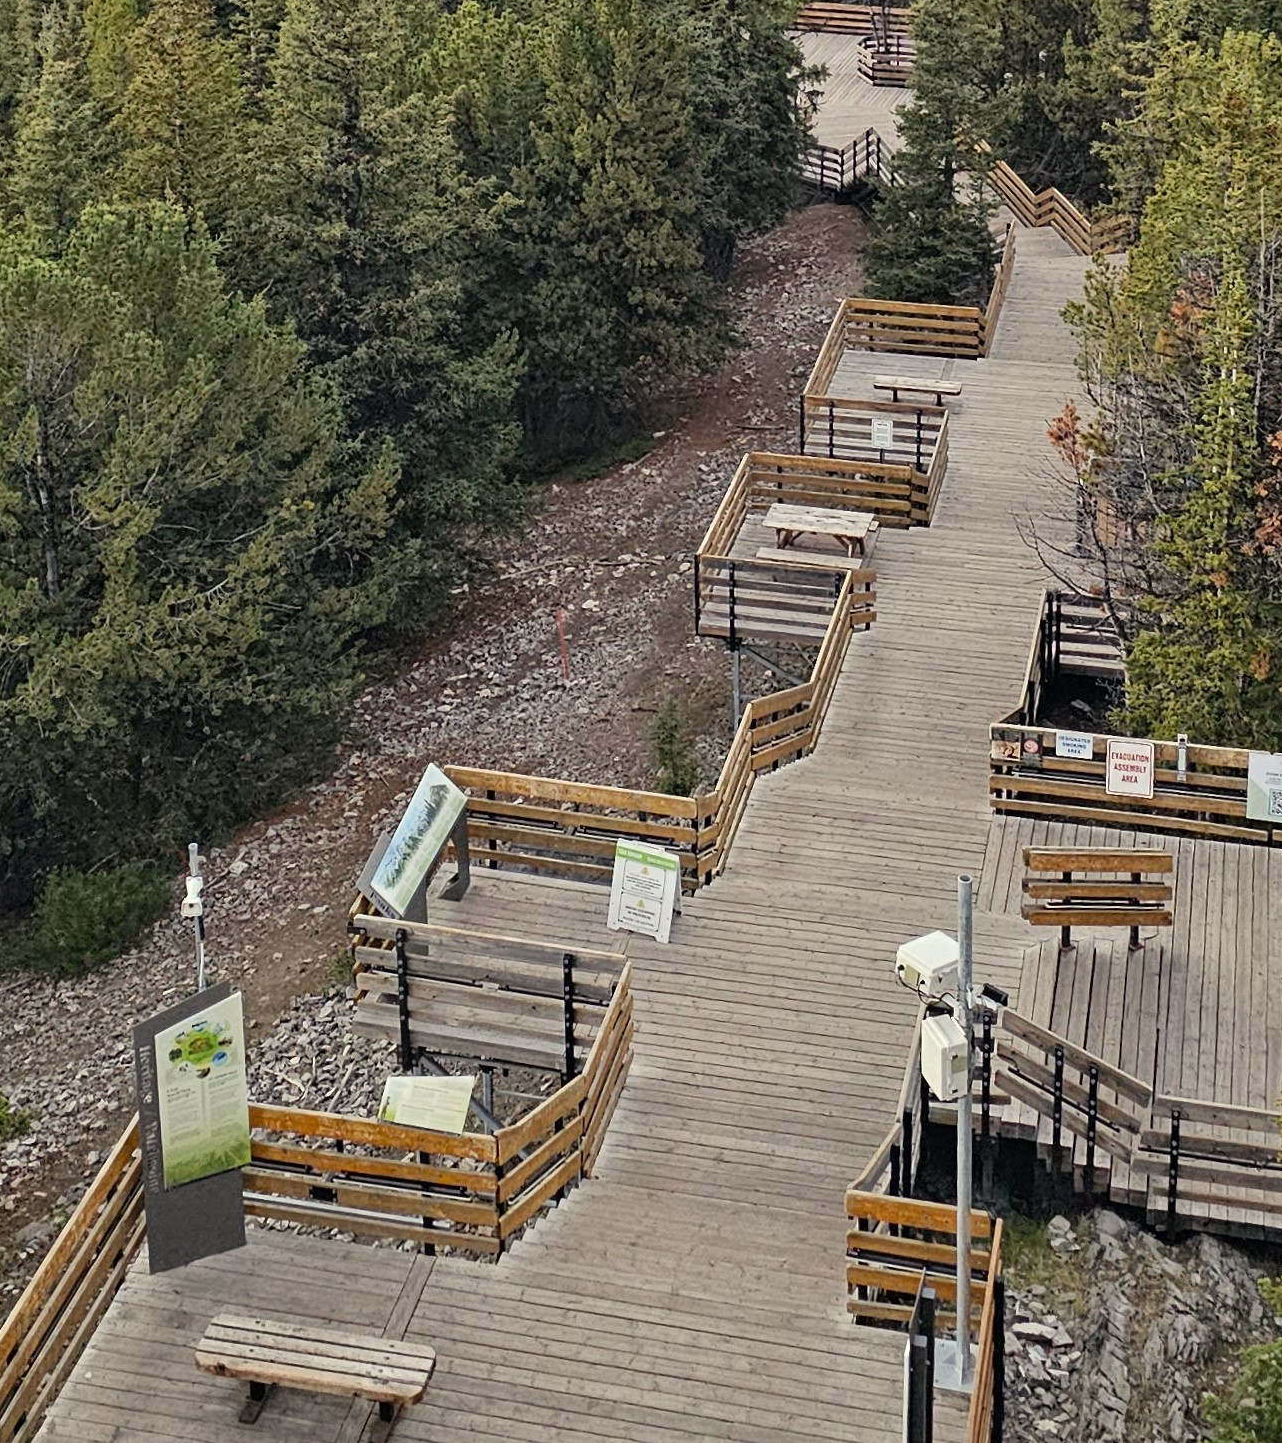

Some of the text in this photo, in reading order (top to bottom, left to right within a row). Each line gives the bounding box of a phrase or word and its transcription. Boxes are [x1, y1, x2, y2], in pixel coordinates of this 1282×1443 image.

[1112, 752, 1149, 762] EVACUATION
[1114, 763, 1146, 773] ASSEMBLY
[1122, 775, 1138, 783] AREA
